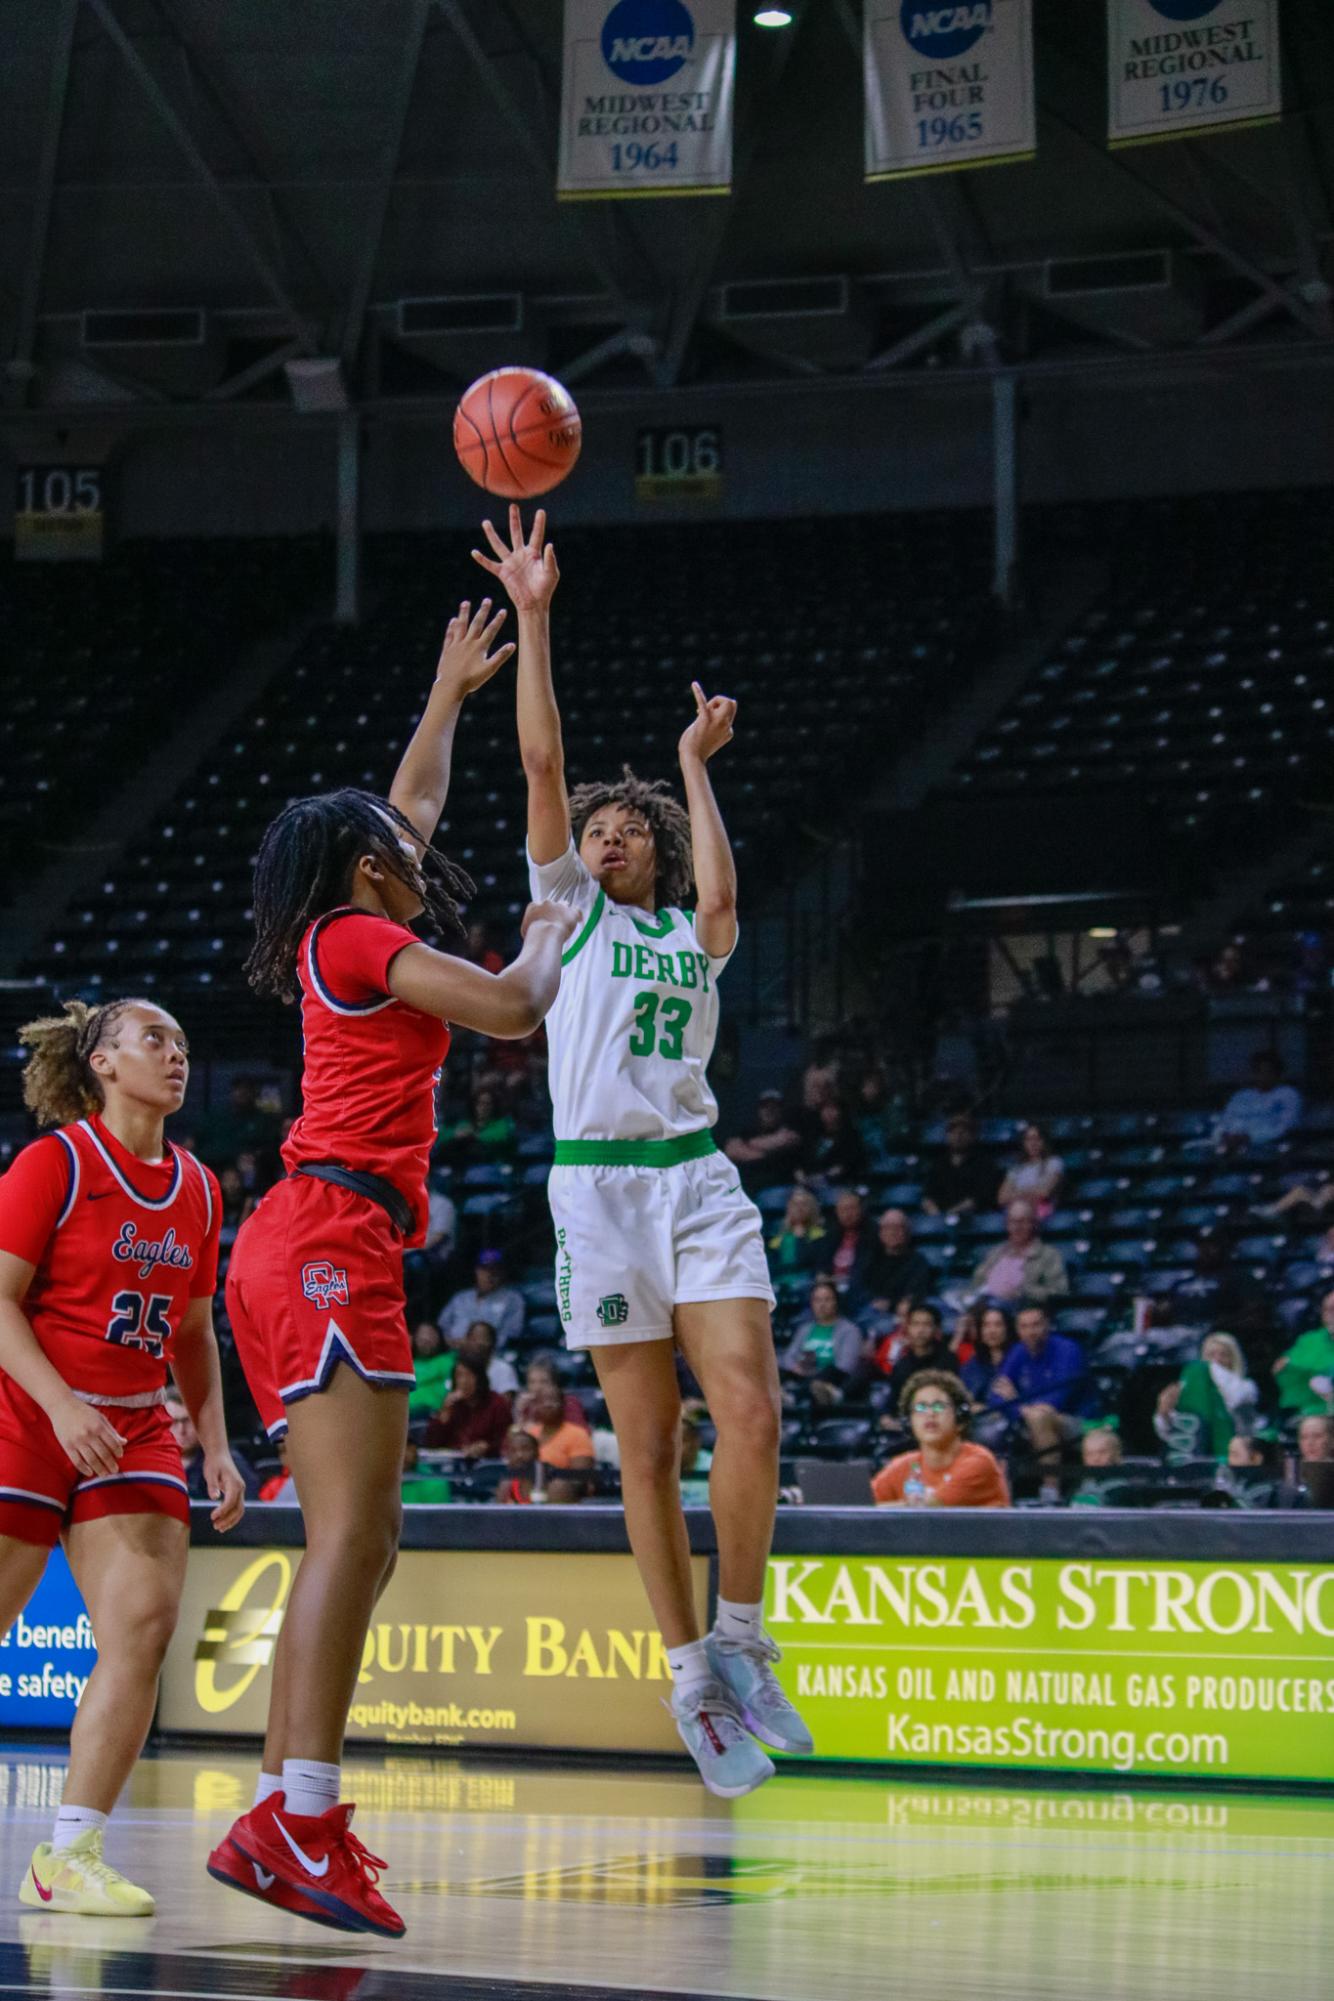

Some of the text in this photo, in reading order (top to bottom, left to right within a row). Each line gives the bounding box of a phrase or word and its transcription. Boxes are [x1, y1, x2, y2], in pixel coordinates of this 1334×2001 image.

[910, 4, 988, 38] NCAA
[1131, 20, 1253, 56] MIDWEST
[610, 35, 692, 62] NCAA
[1124, 42, 1263, 81] REGIONAL
[910, 64, 989, 92] FINAL
[1160, 75, 1228, 112] 1976
[586, 92, 708, 114] MIDWEST
[914, 86, 985, 112] FOUR
[578, 114, 716, 137] REGIONAL
[918, 112, 983, 147] 1965
[611, 141, 678, 172] 1964
[640, 432, 719, 480] 106
[20, 470, 100, 517] 105
[611, 941, 709, 993] DERBY
[629, 991, 693, 1060] 33
[112, 1221, 193, 1279] Eagles
[105, 1290, 173, 1358] 25
[767, 1561, 1036, 1629] KANSAS
[18, 1662, 89, 1707] safety
[797, 1665, 1334, 1713] KANSAS OIL AND NATURAL GAS PRODUCERS
[888, 1713, 1229, 1771] KansasStrong.com
